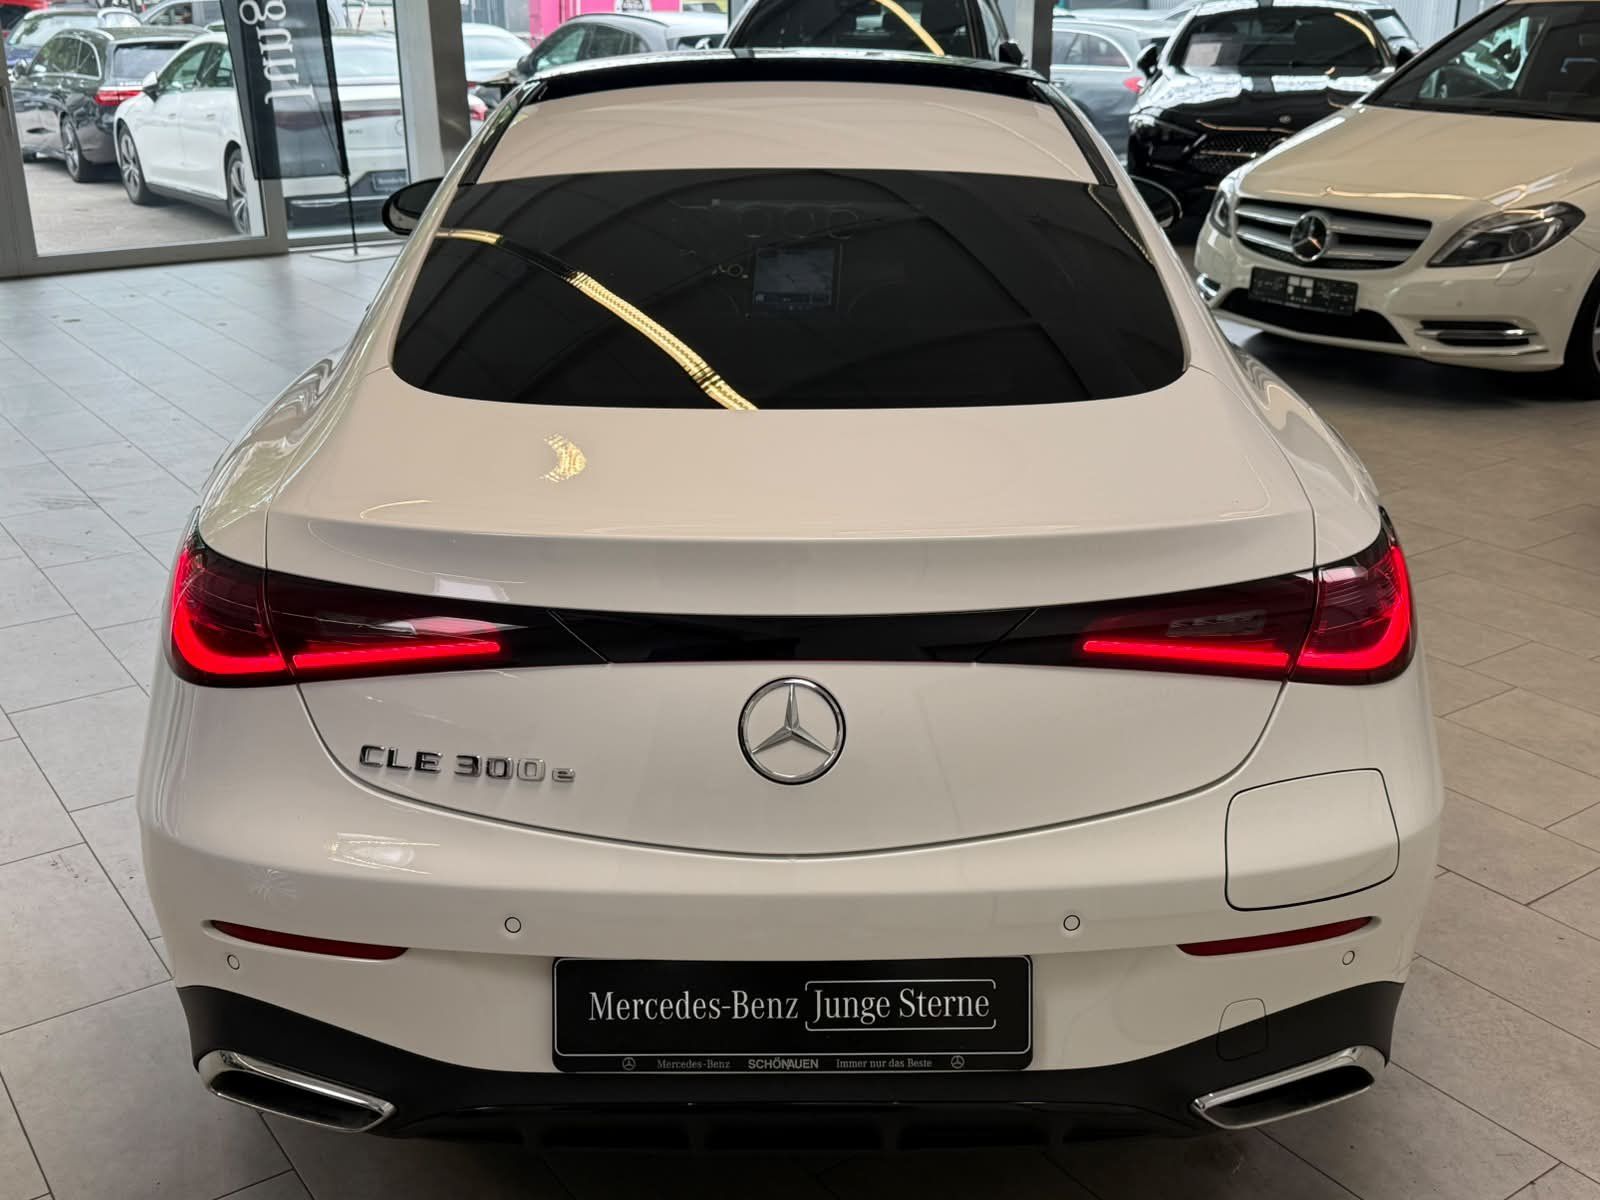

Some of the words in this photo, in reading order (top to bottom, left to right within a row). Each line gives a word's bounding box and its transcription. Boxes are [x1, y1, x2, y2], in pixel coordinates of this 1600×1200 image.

[358, 744, 443, 775] CLE
[588, 989, 799, 1021] Mercedes-Benz
[812, 988, 891, 1024] Junge
[898, 986, 991, 1018] Sterne
[656, 1058, 732, 1070] Mercedes-Benz
[747, 1056, 820, 1071] SCHÖNAUEN
[835, 1058, 868, 1069] Immer
[869, 1060, 886, 1069] nur
[888, 1058, 905, 1069] das
[907, 1058, 934, 1069] Beste
